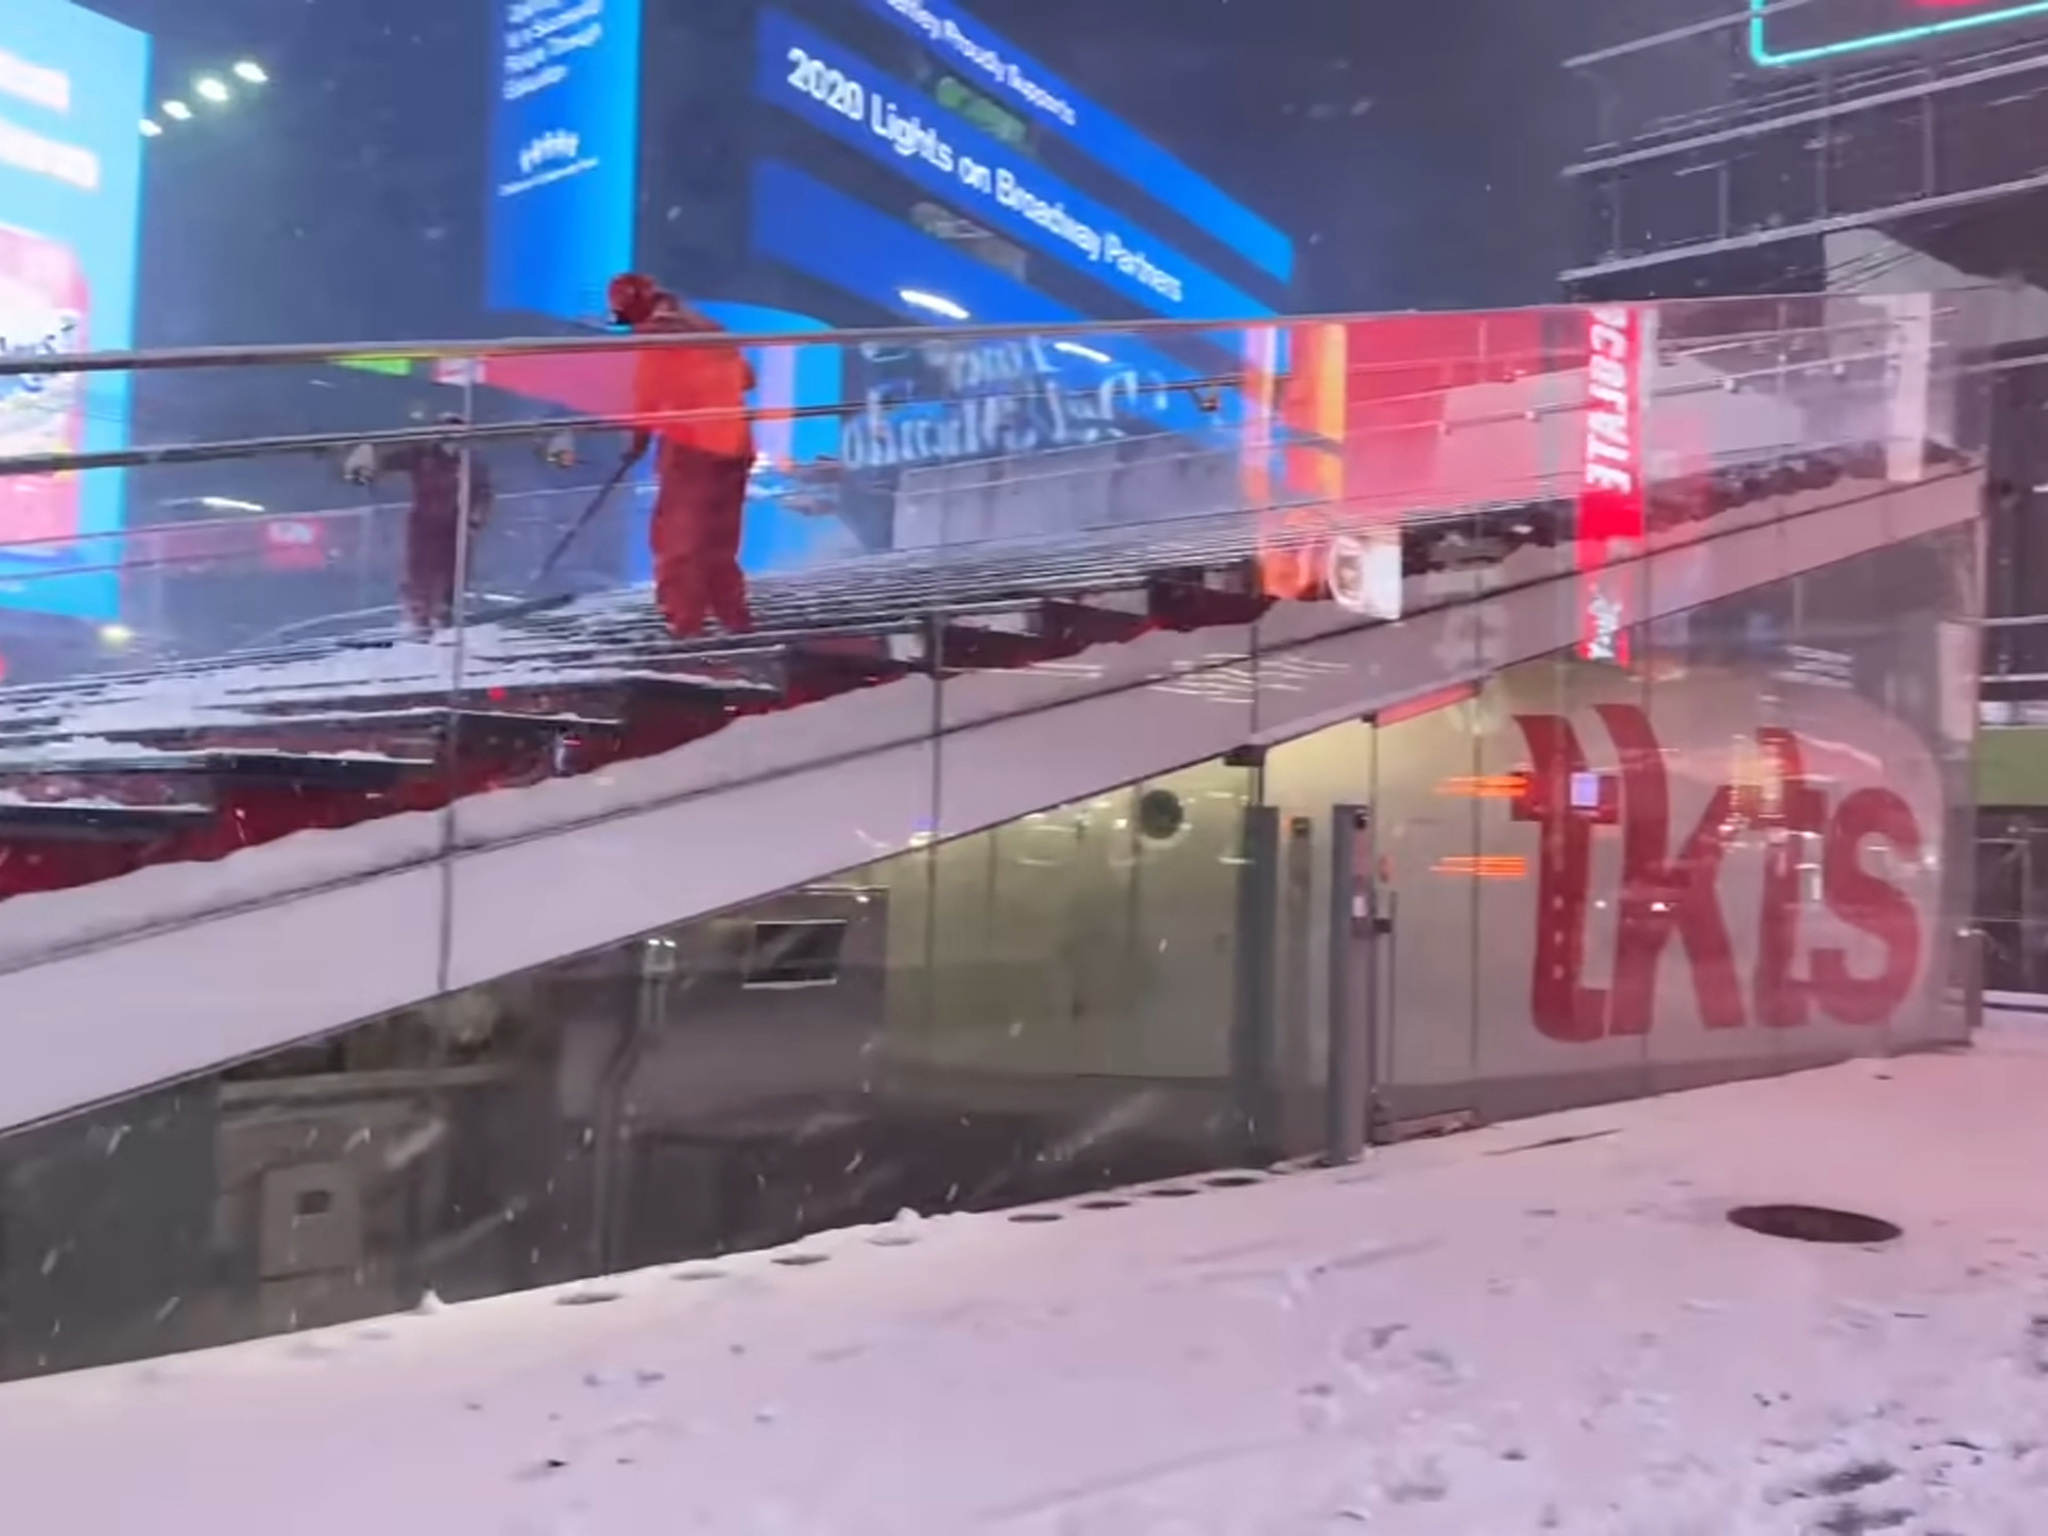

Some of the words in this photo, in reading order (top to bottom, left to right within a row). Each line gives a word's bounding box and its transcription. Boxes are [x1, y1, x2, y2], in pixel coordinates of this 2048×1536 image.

[787, 47, 864, 120] 2020
[870, 93, 955, 172] Lights
[958, 157, 992, 194] on
[995, 168, 1101, 261] Broadway
[1103, 232, 1182, 302] Partners
[1511, 703, 1923, 1042] tkts
